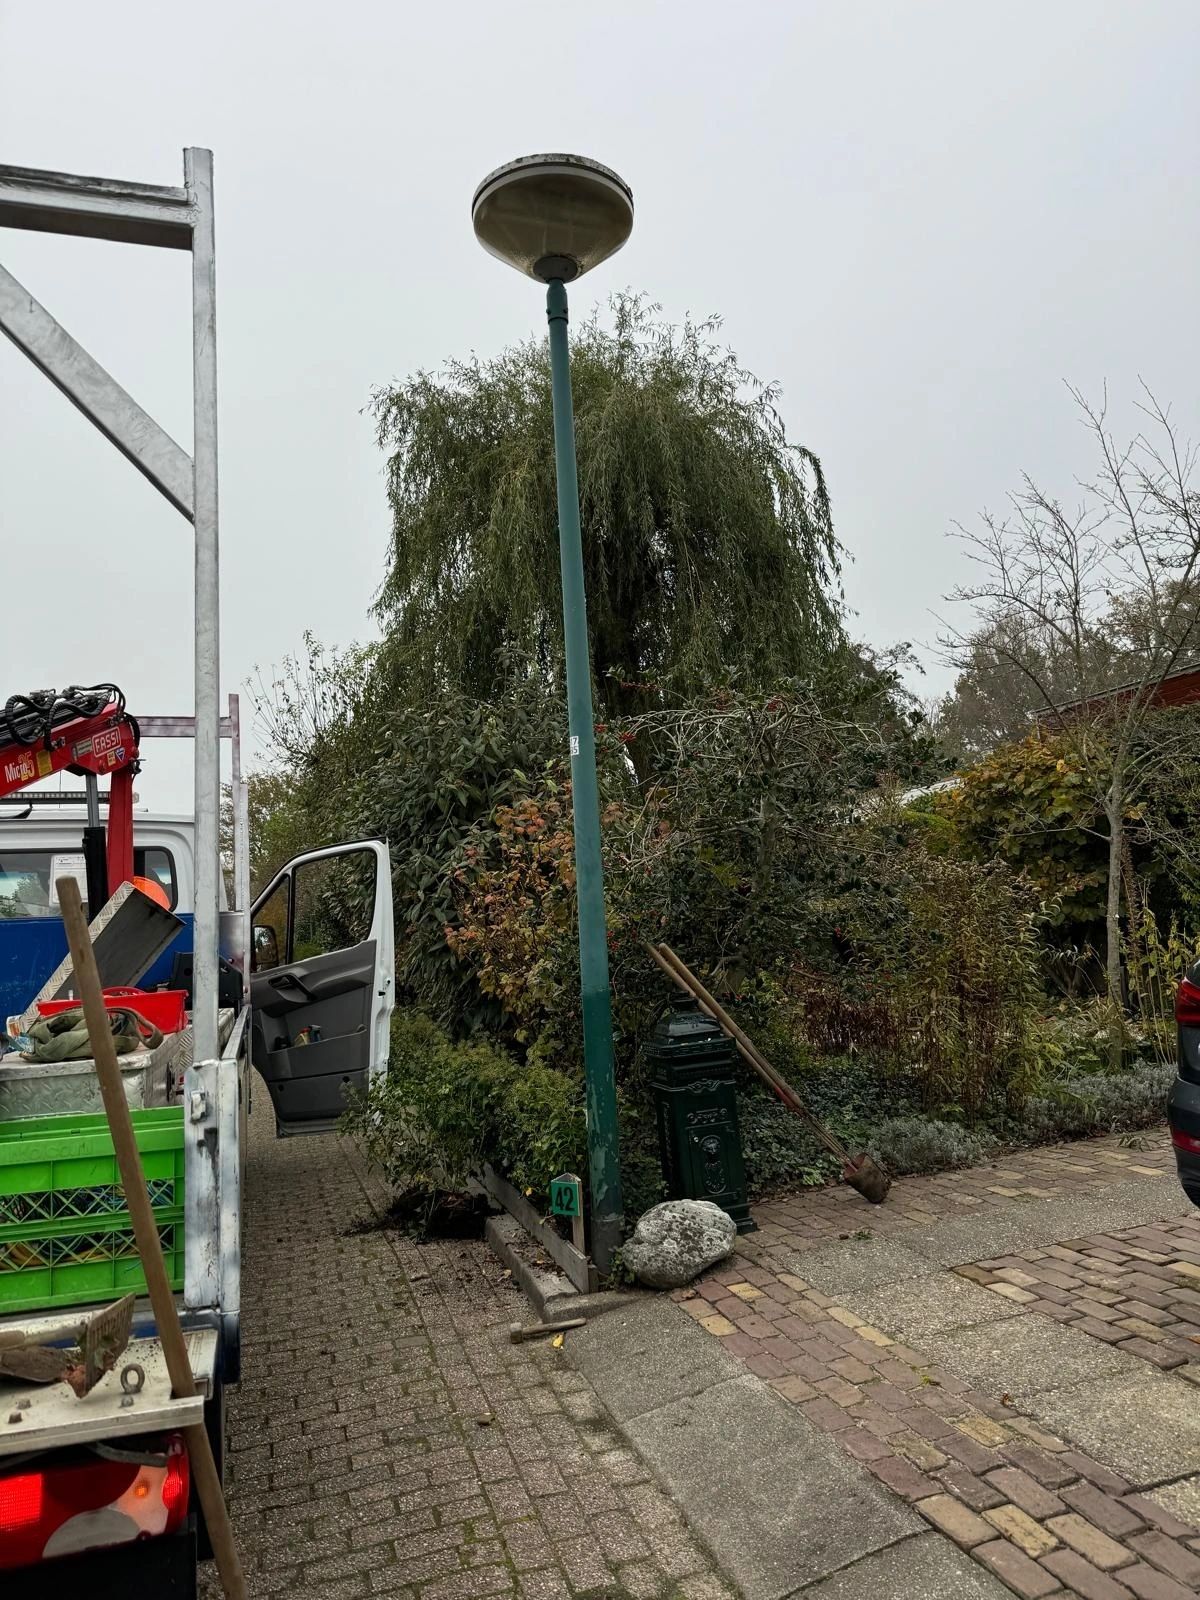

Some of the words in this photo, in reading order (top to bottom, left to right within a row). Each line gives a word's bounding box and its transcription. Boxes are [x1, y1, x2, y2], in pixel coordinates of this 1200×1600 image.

[94, 730, 120, 753] FASSI
[4, 762, 28, 783] Micro
[555, 1186, 575, 1211] 42
